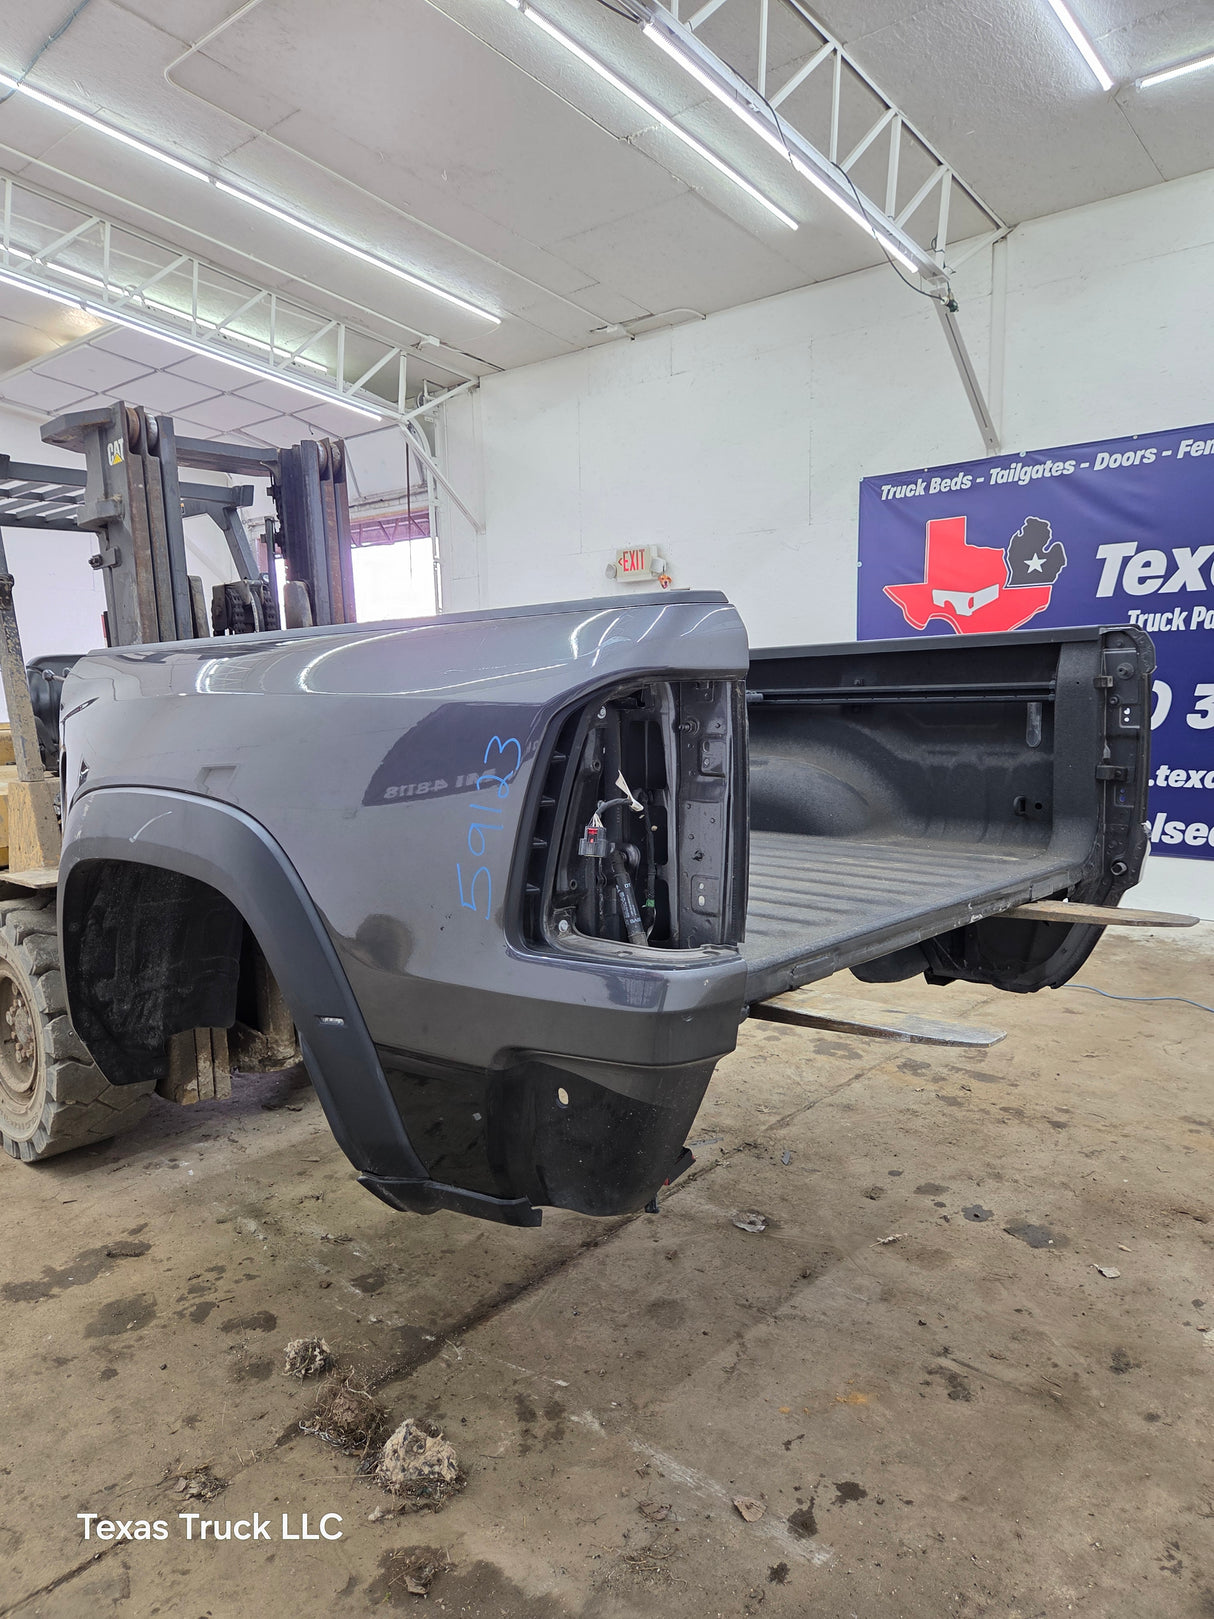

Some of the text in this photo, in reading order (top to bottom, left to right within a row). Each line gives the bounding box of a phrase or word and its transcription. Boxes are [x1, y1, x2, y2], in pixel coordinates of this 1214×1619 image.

[107, 437, 125, 466] CAT
[880, 476, 925, 500] Truck
[928, 472, 973, 494] Beds
[989, 459, 1076, 486] Tailgates
[1093, 447, 1157, 471] Doors
[622, 548, 645, 572] EXIT
[1095, 541, 1214, 598] Tex
[1127, 607, 1188, 633] Truck
[456, 735, 522, 920] 59123
